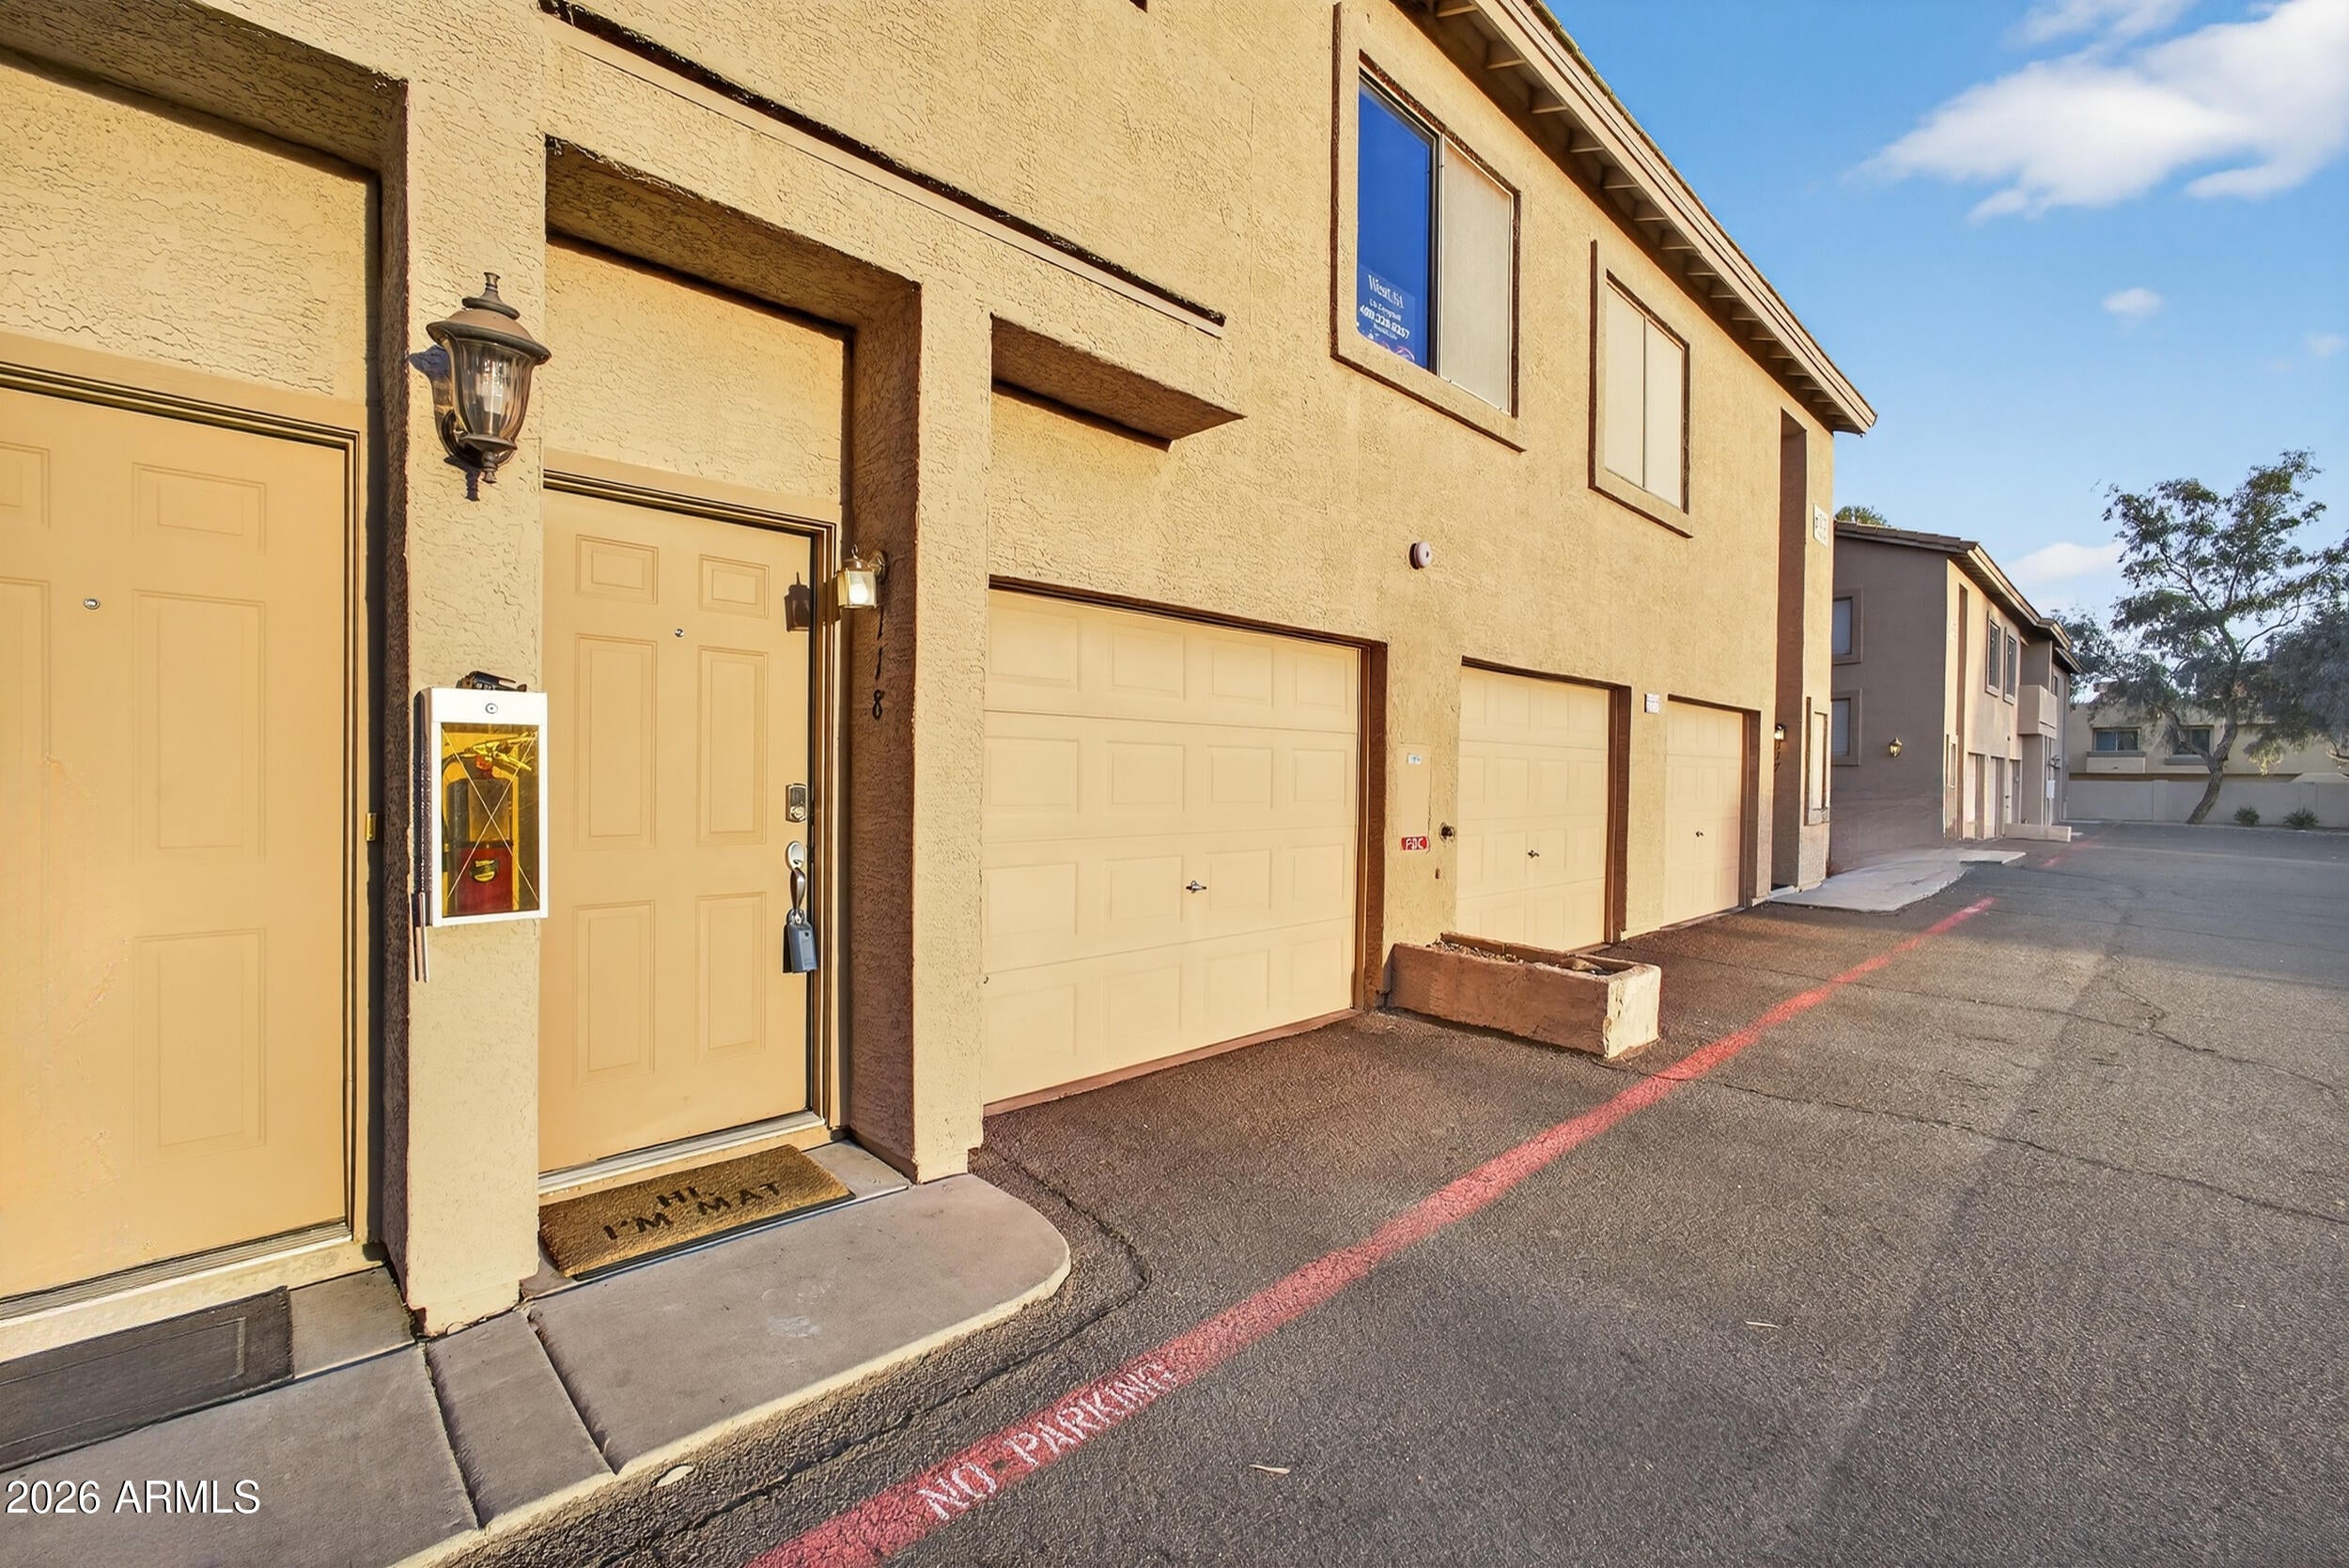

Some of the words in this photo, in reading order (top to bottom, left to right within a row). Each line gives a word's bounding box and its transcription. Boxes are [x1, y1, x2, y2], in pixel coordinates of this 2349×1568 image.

[602, 1211, 673, 1241] I'M
[695, 1181, 782, 1216] MAT
[916, 1462, 997, 1521] NO
[1003, 1362, 1177, 1467] PARKING
